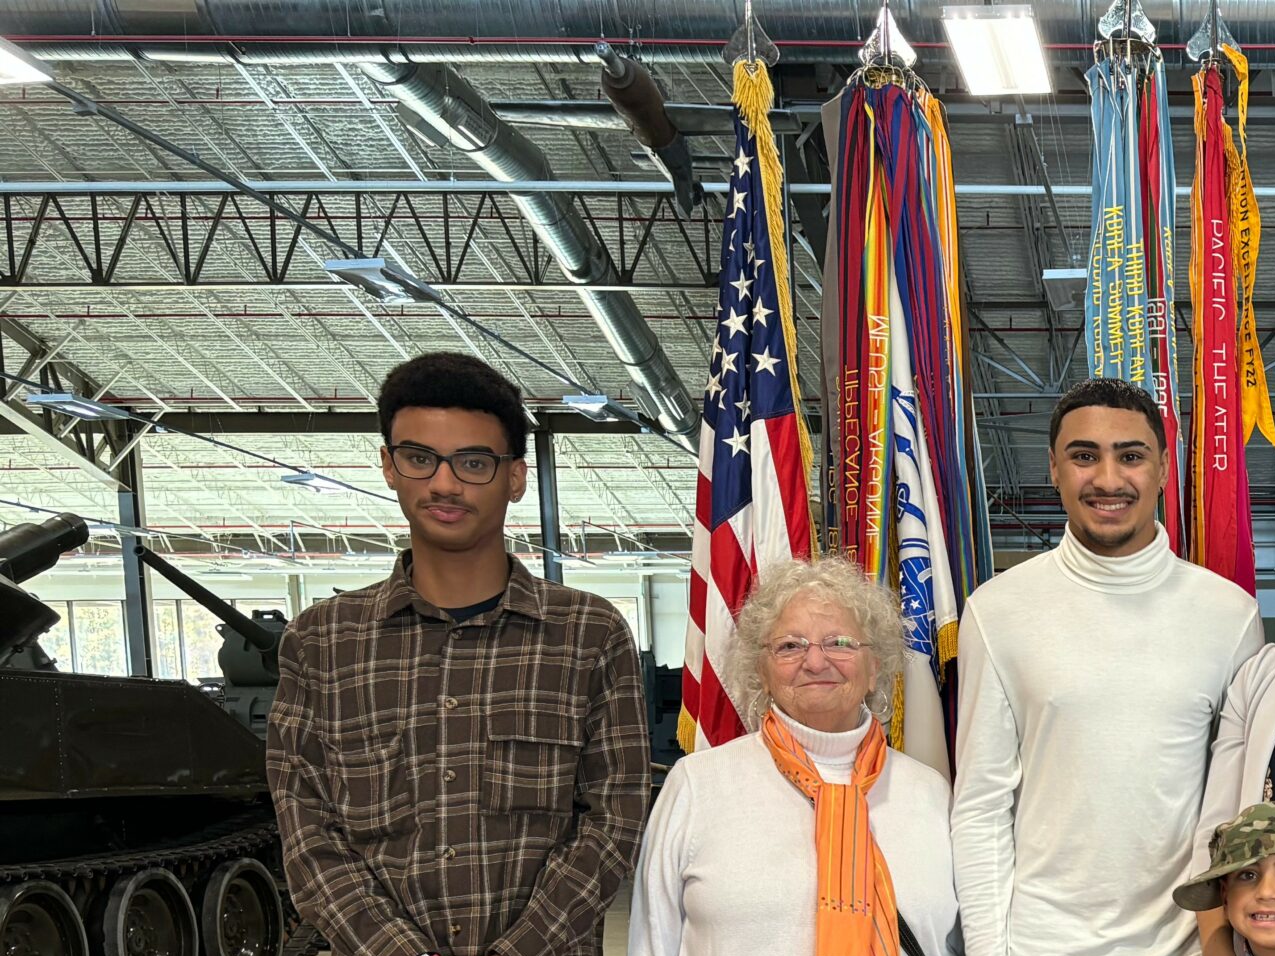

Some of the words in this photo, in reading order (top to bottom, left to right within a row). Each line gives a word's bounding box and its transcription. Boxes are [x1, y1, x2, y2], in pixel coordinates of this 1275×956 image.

[1103, 205, 1124, 271] KOREA
[1125, 238, 1144, 296] THIRD
[1108, 282, 1125, 364] SUMMER
[1127, 305, 1146, 382] KOREAN
[1244, 349, 1257, 387] FY22
[1212, 343, 1228, 471] THEATER
